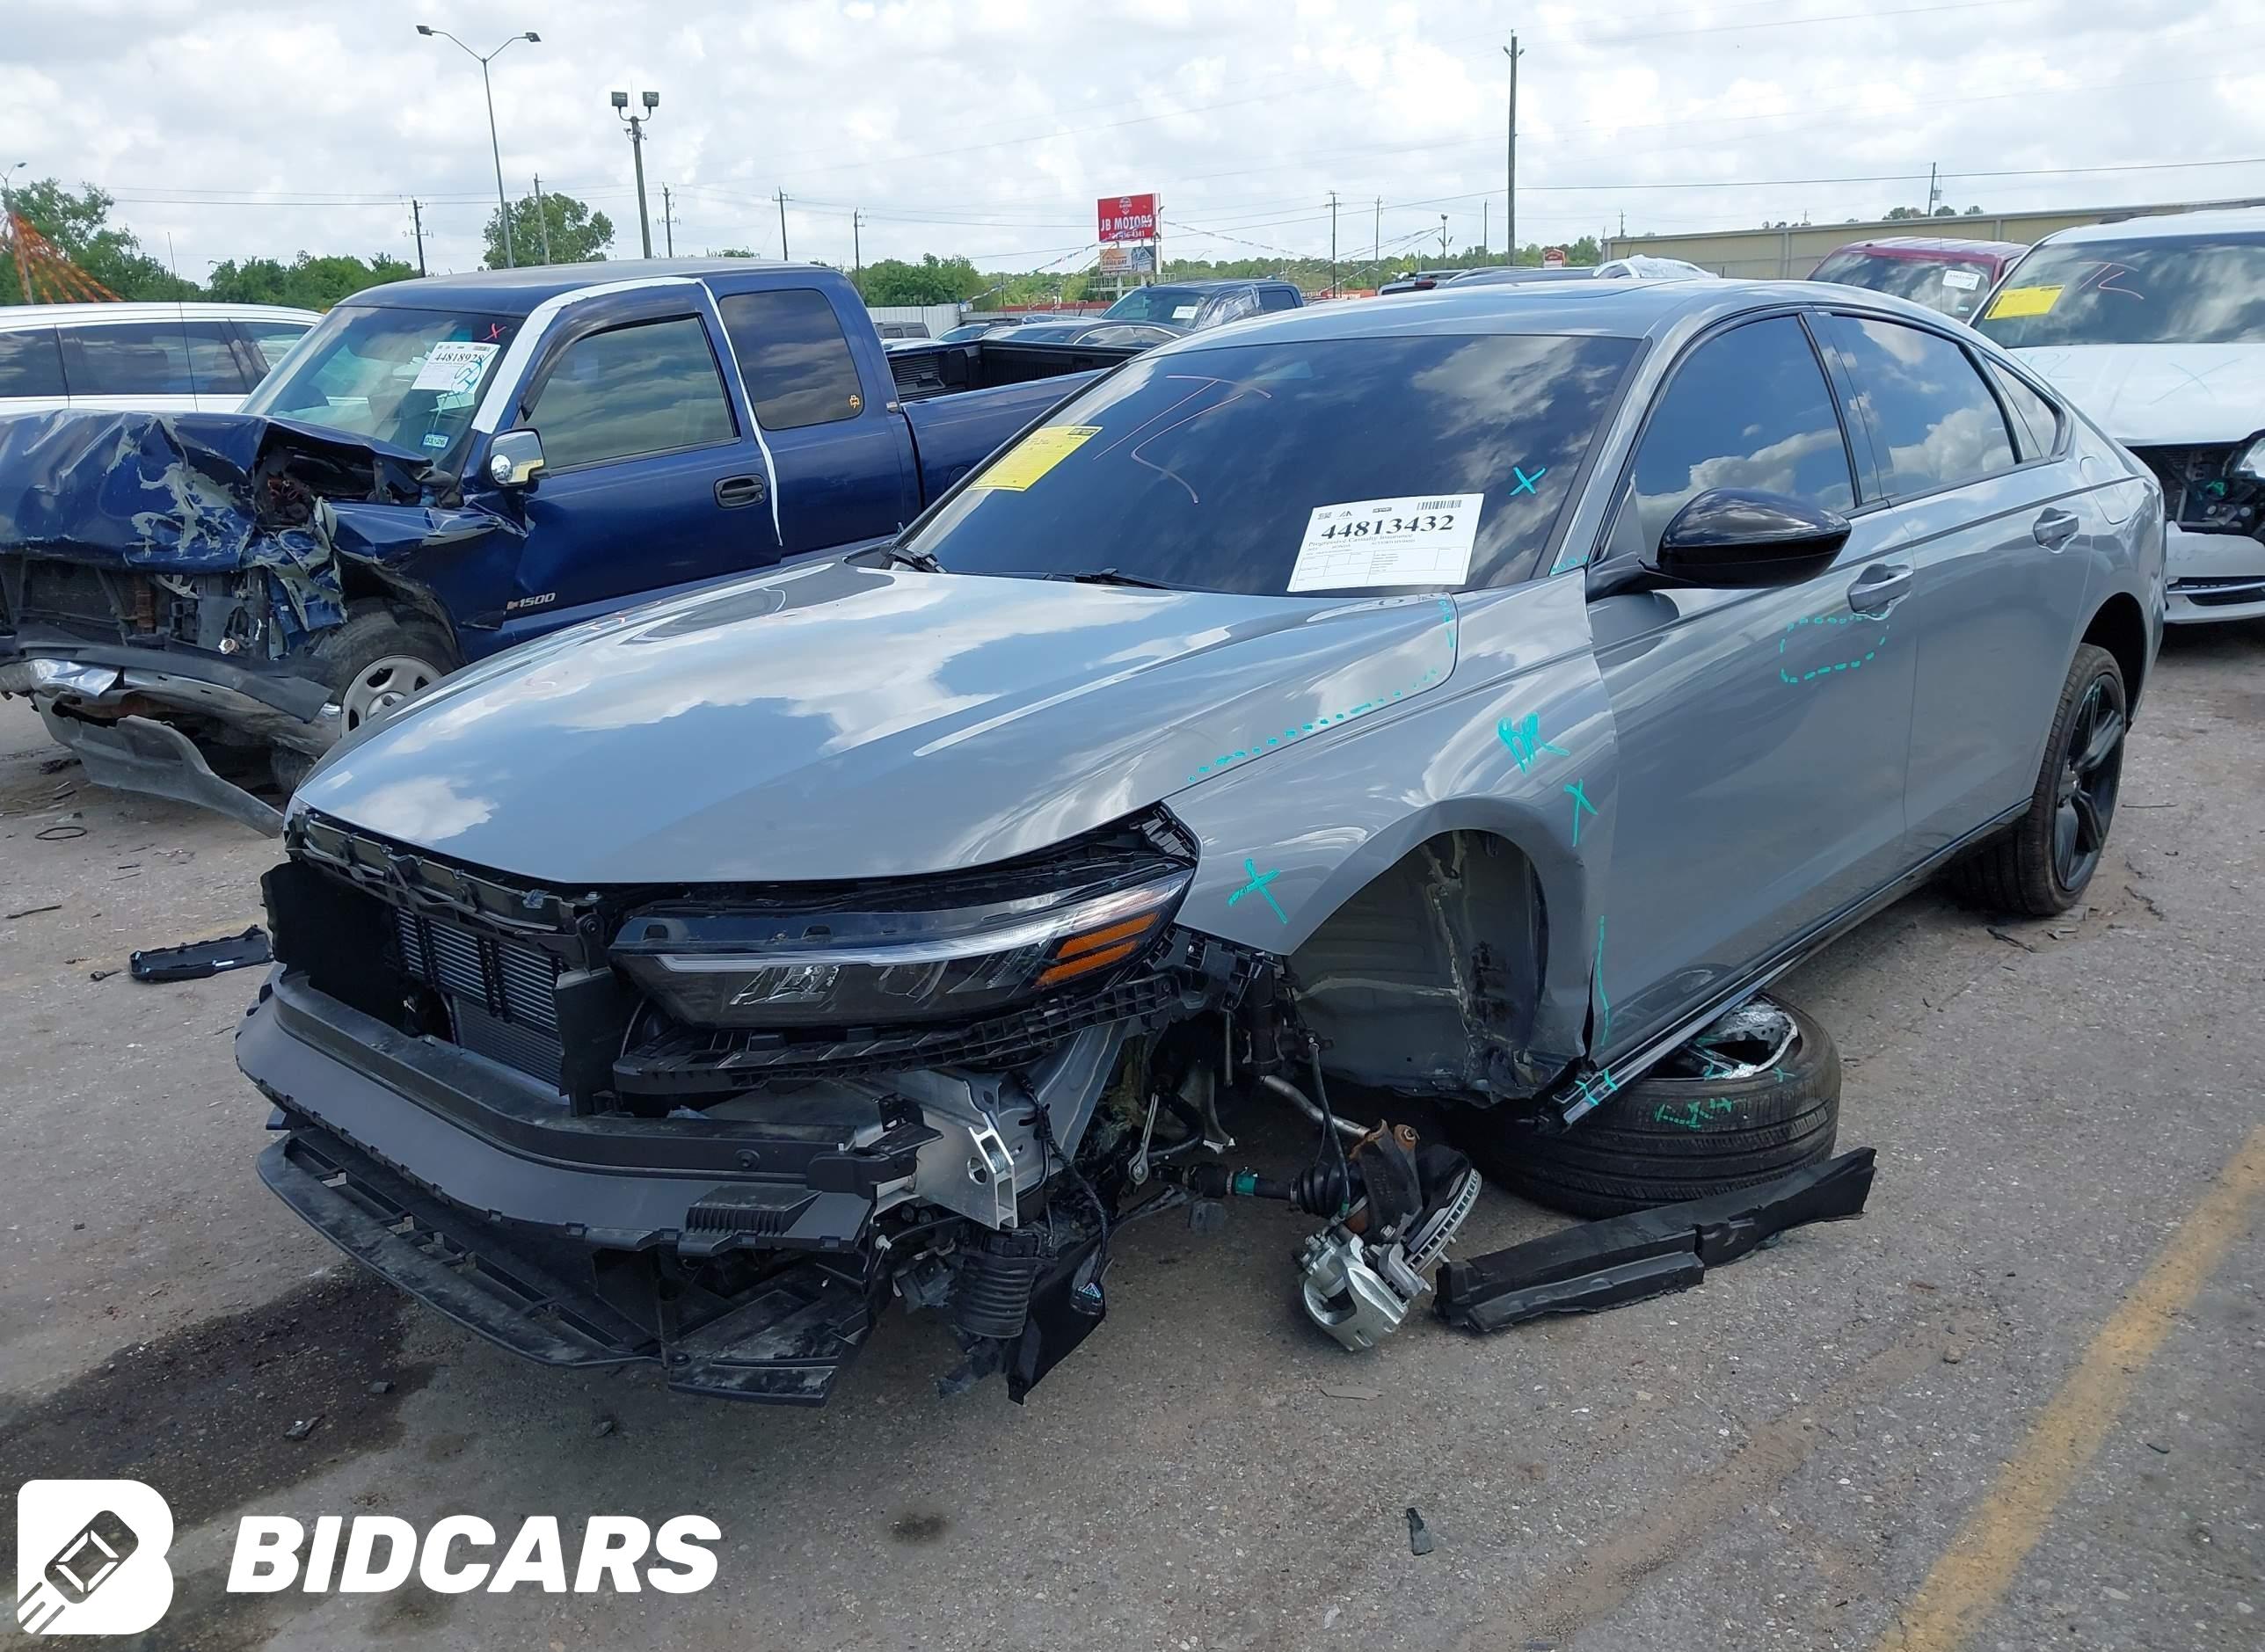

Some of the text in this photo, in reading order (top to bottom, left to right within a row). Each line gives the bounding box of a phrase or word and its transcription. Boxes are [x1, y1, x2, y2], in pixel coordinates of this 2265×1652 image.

[1101, 215, 1153, 231] JB MOTORS
[1322, 514, 1454, 539] 44813432
[521, 593, 556, 608] 1500
